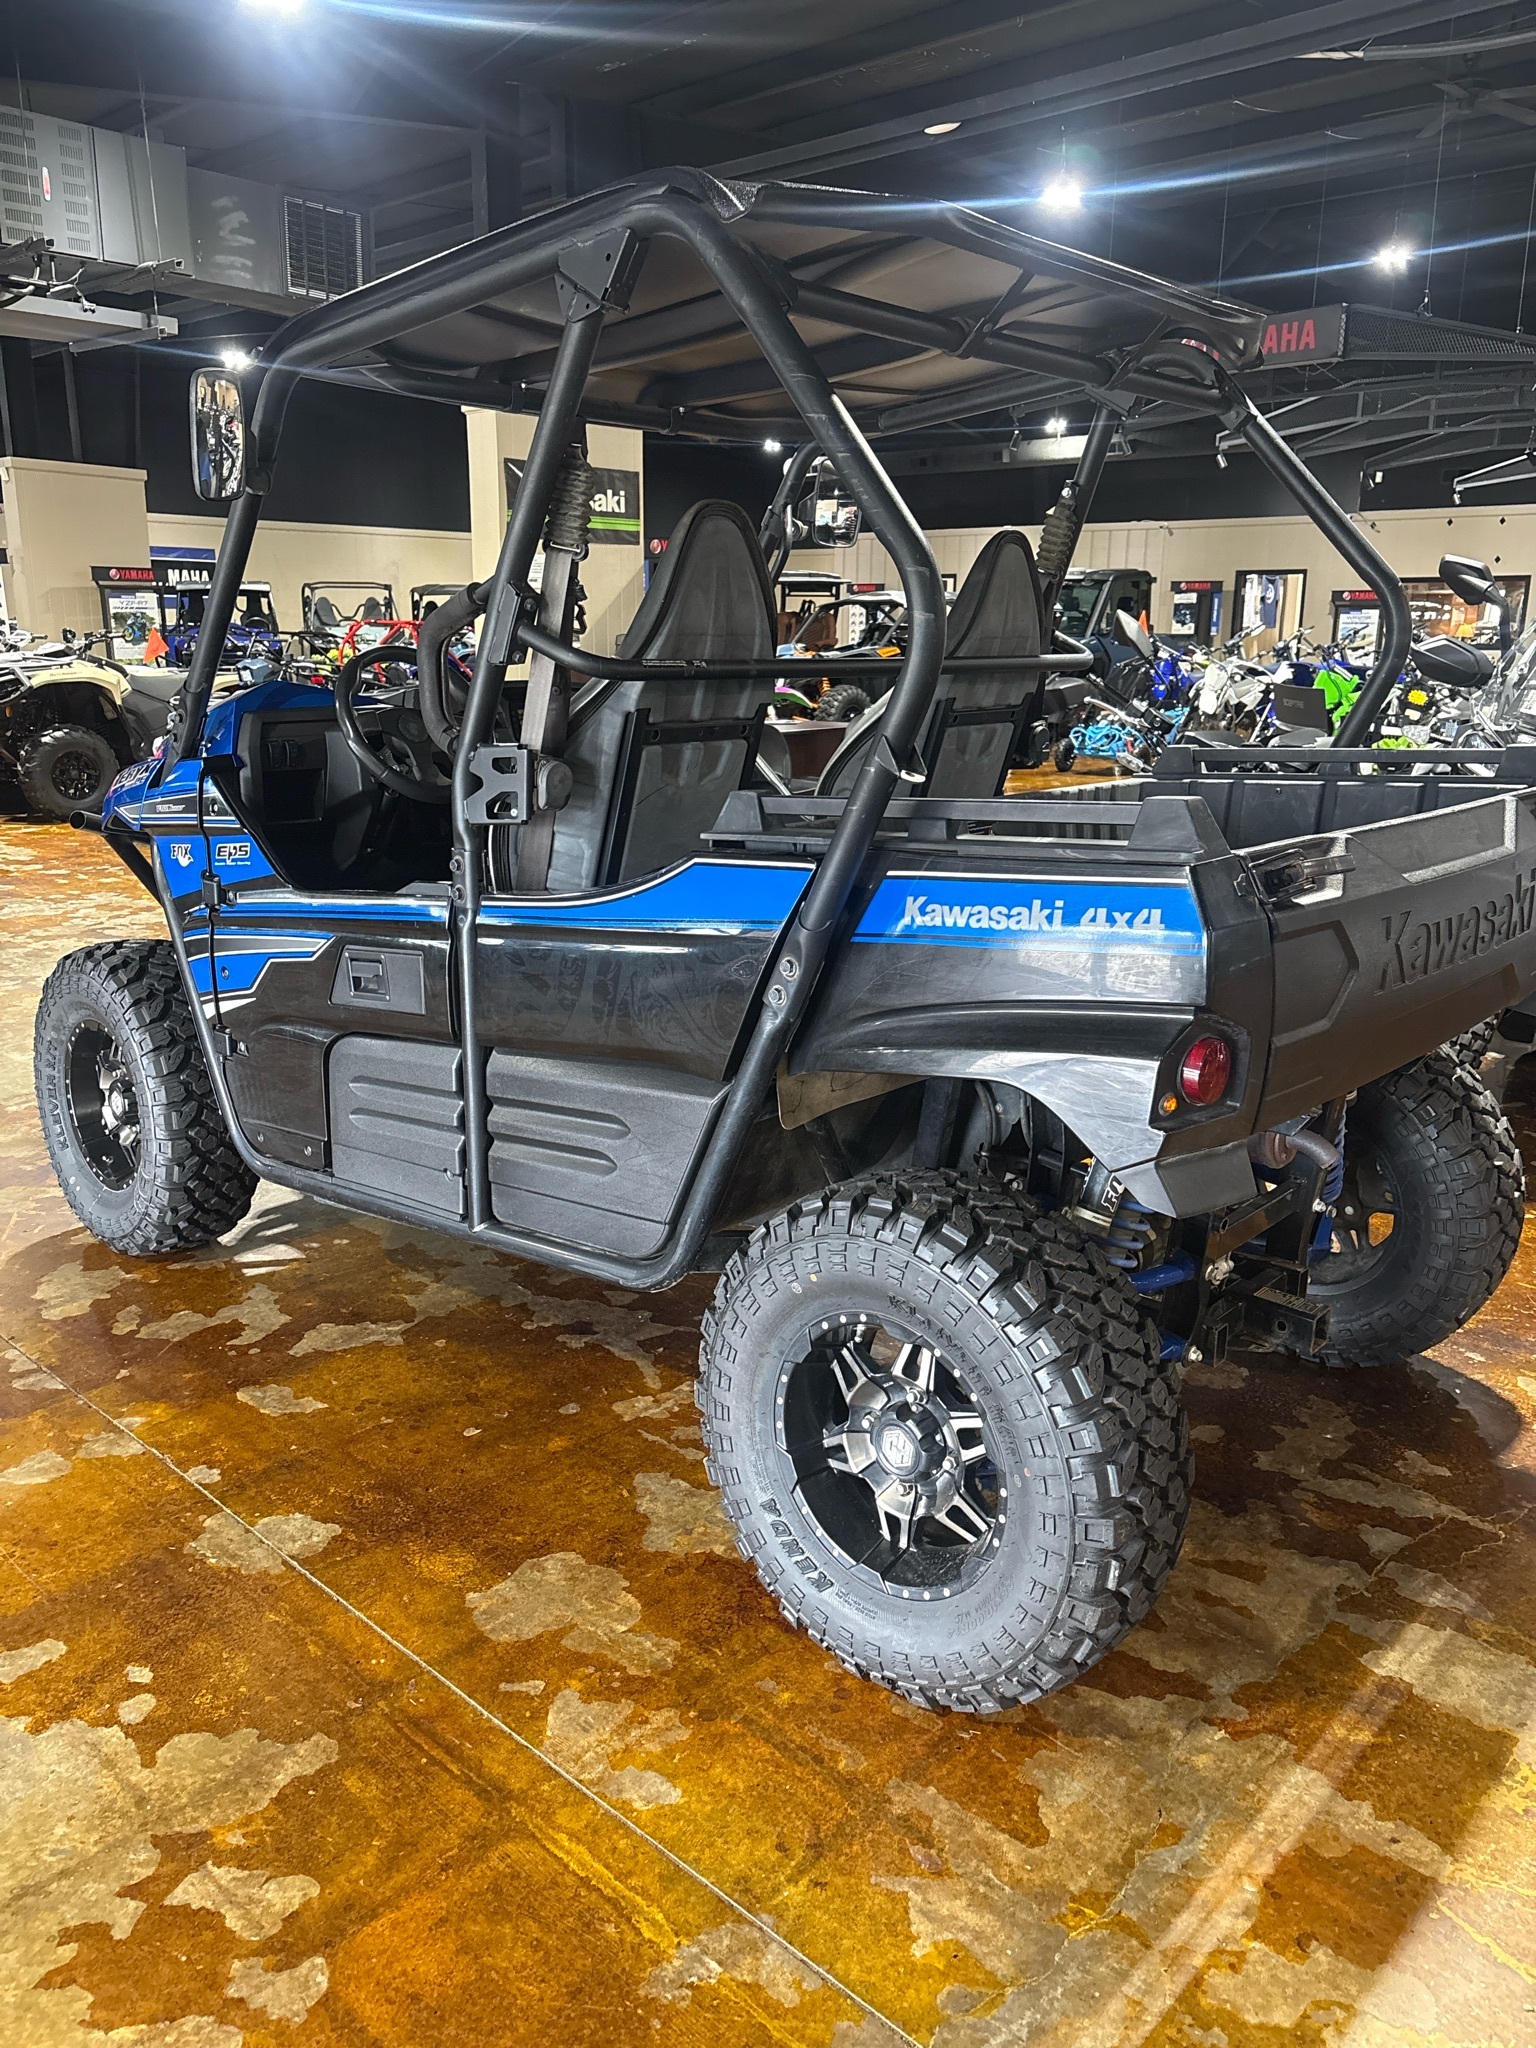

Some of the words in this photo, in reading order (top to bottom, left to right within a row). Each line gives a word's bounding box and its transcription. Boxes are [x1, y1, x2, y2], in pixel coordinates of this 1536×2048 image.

[1262, 319, 1316, 355] AHA
[588, 489, 626, 513] aki
[120, 569, 154, 580] YAMAHA
[166, 568, 210, 586] MAHA
[171, 844, 192, 859] FOX
[904, 895, 1064, 931] Kawasaki
[1080, 907, 1166, 930] 4x4
[1373, 867, 1536, 996] Kawasaki
[1100, 1172, 1125, 1213] FO
[759, 1497, 835, 1594] KENDA
